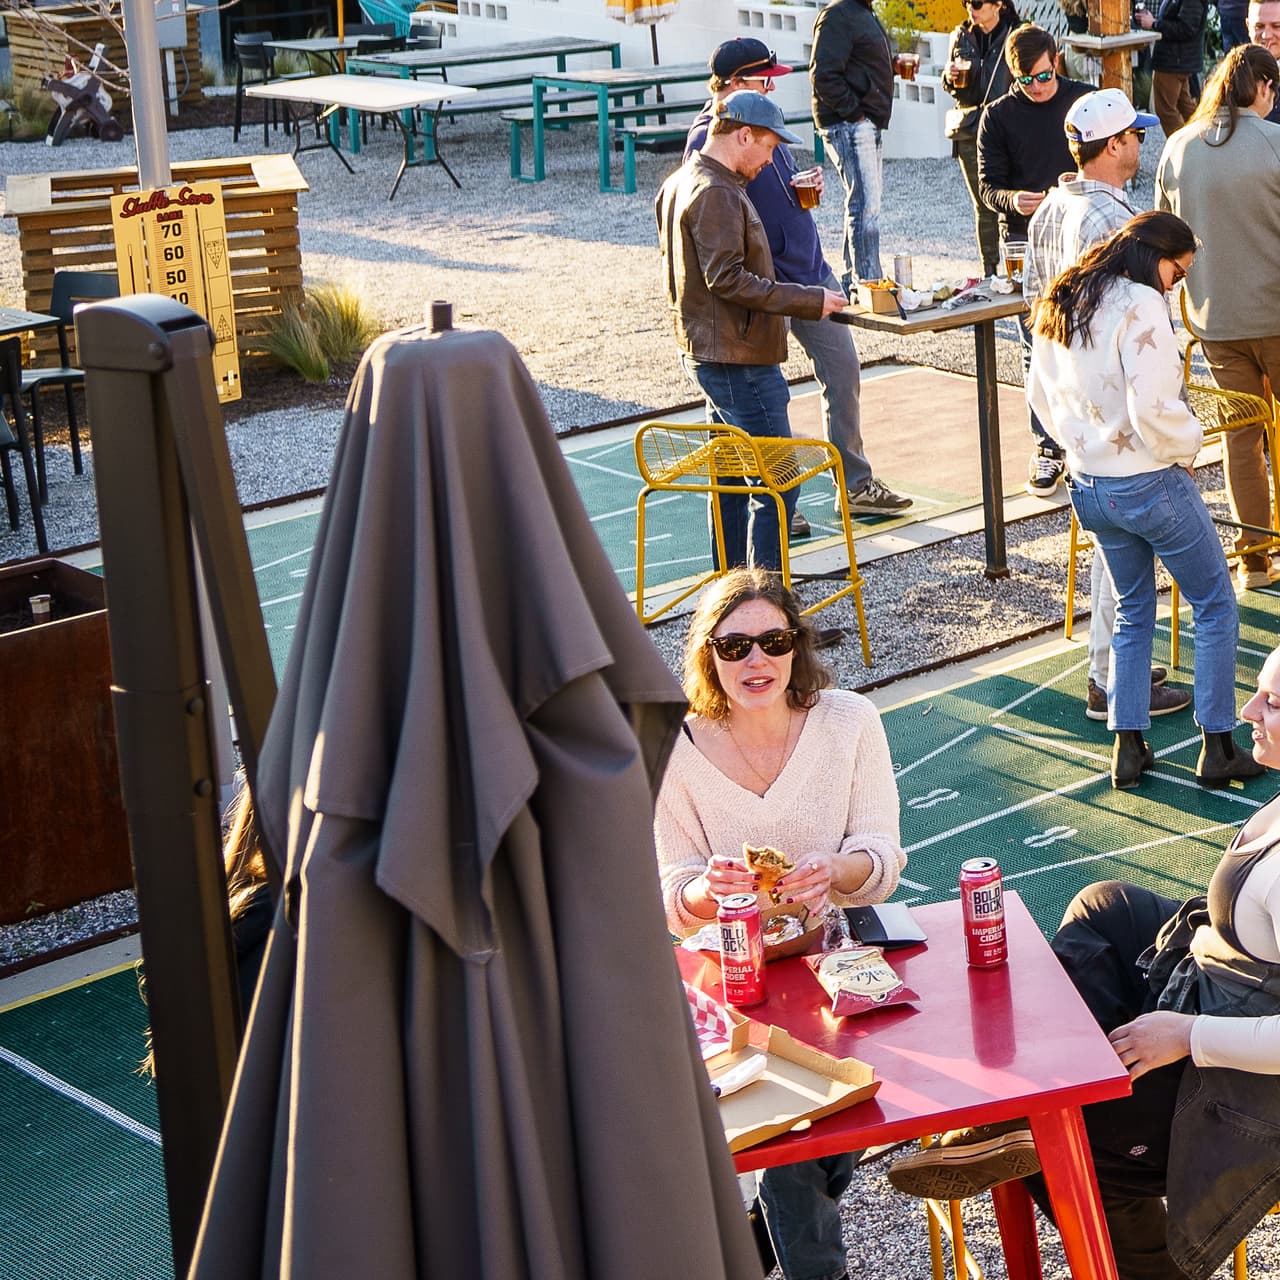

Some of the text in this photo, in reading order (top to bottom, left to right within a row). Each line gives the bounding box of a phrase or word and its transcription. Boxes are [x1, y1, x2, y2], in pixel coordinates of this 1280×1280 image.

[161, 222, 182, 239] 70
[163, 245, 185, 261] 60
[166, 269, 187, 285] 50
[973, 886, 1001, 905] BOLD
[974, 899, 1003, 915] ROCK
[720, 926, 744, 940] OLD
[980, 931, 1003, 943] CIDER
[721, 938, 747, 952] OCK
[723, 965, 753, 974] PERIAL
